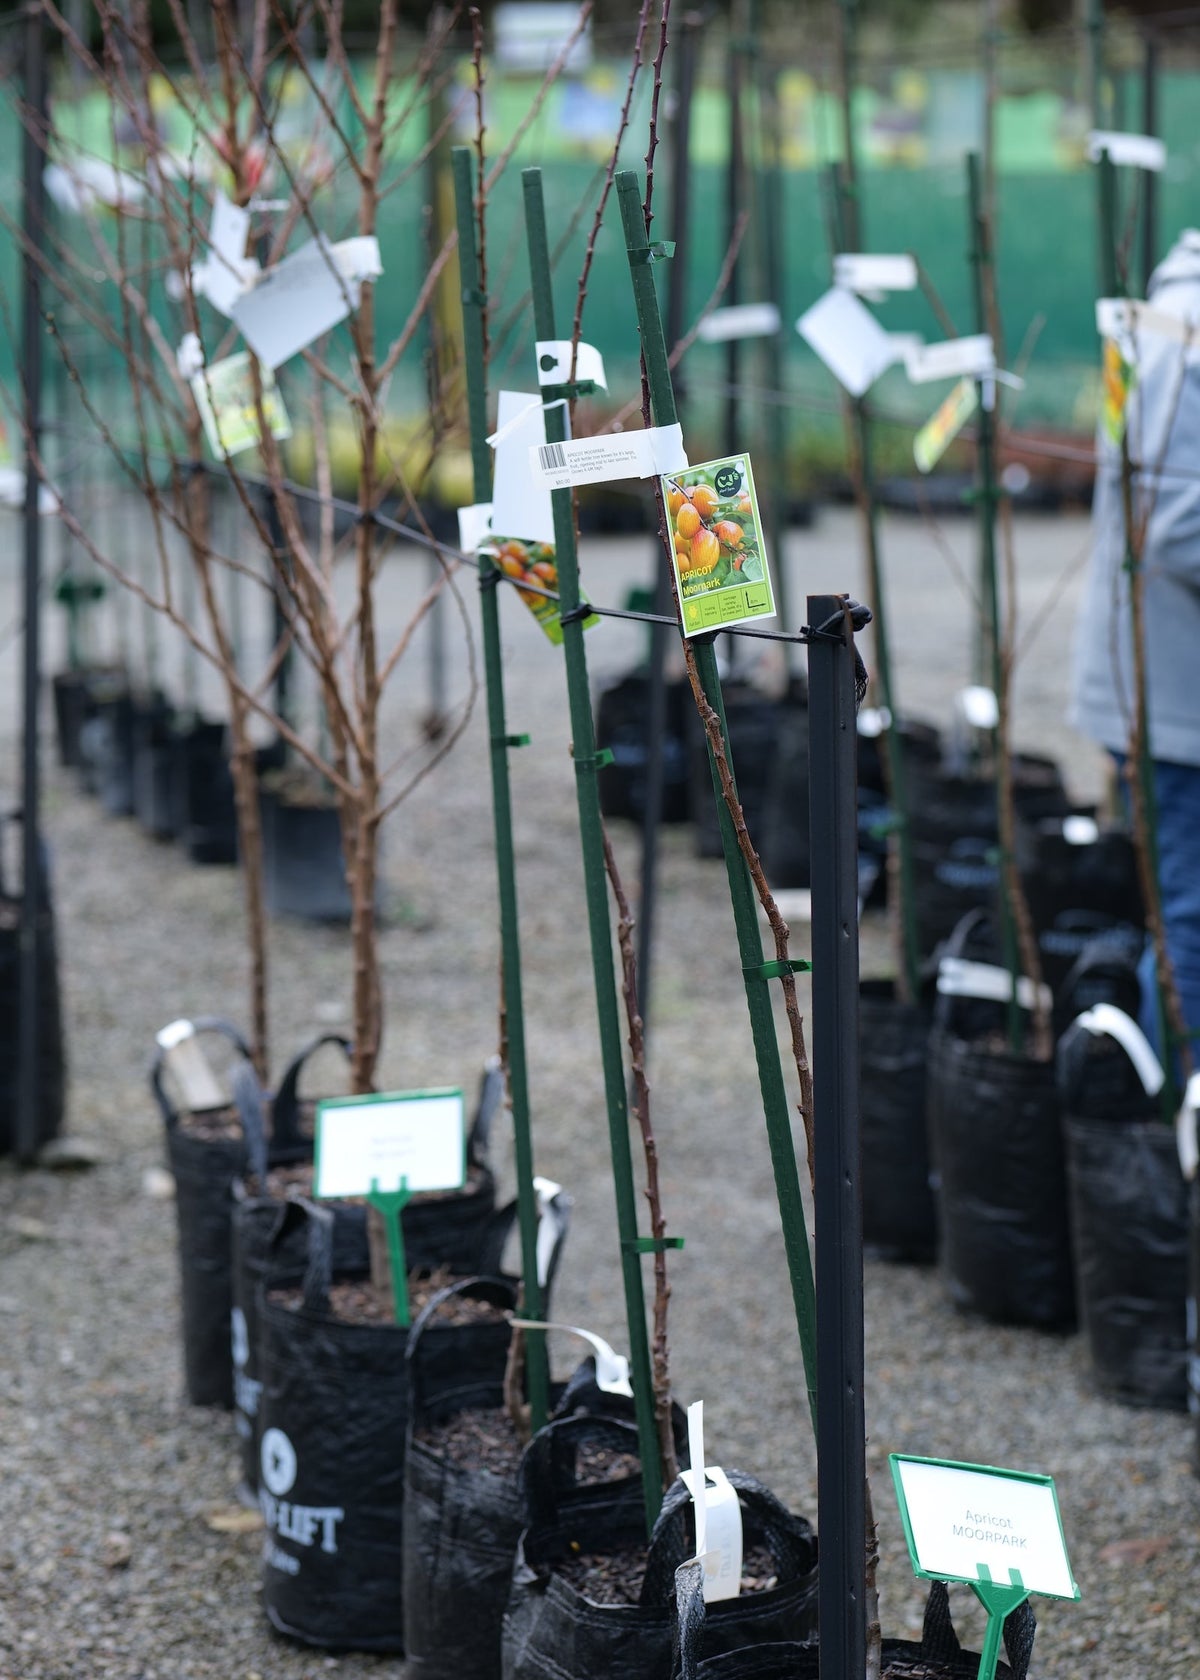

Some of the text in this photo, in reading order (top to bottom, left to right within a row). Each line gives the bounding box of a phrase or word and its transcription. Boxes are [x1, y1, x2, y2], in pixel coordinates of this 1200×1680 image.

[681, 564, 712, 582] APRICOT
[683, 577, 721, 596] Moorpark
[965, 1509, 1014, 1529] Apricot
[952, 1524, 1028, 1549] MOORPARK
